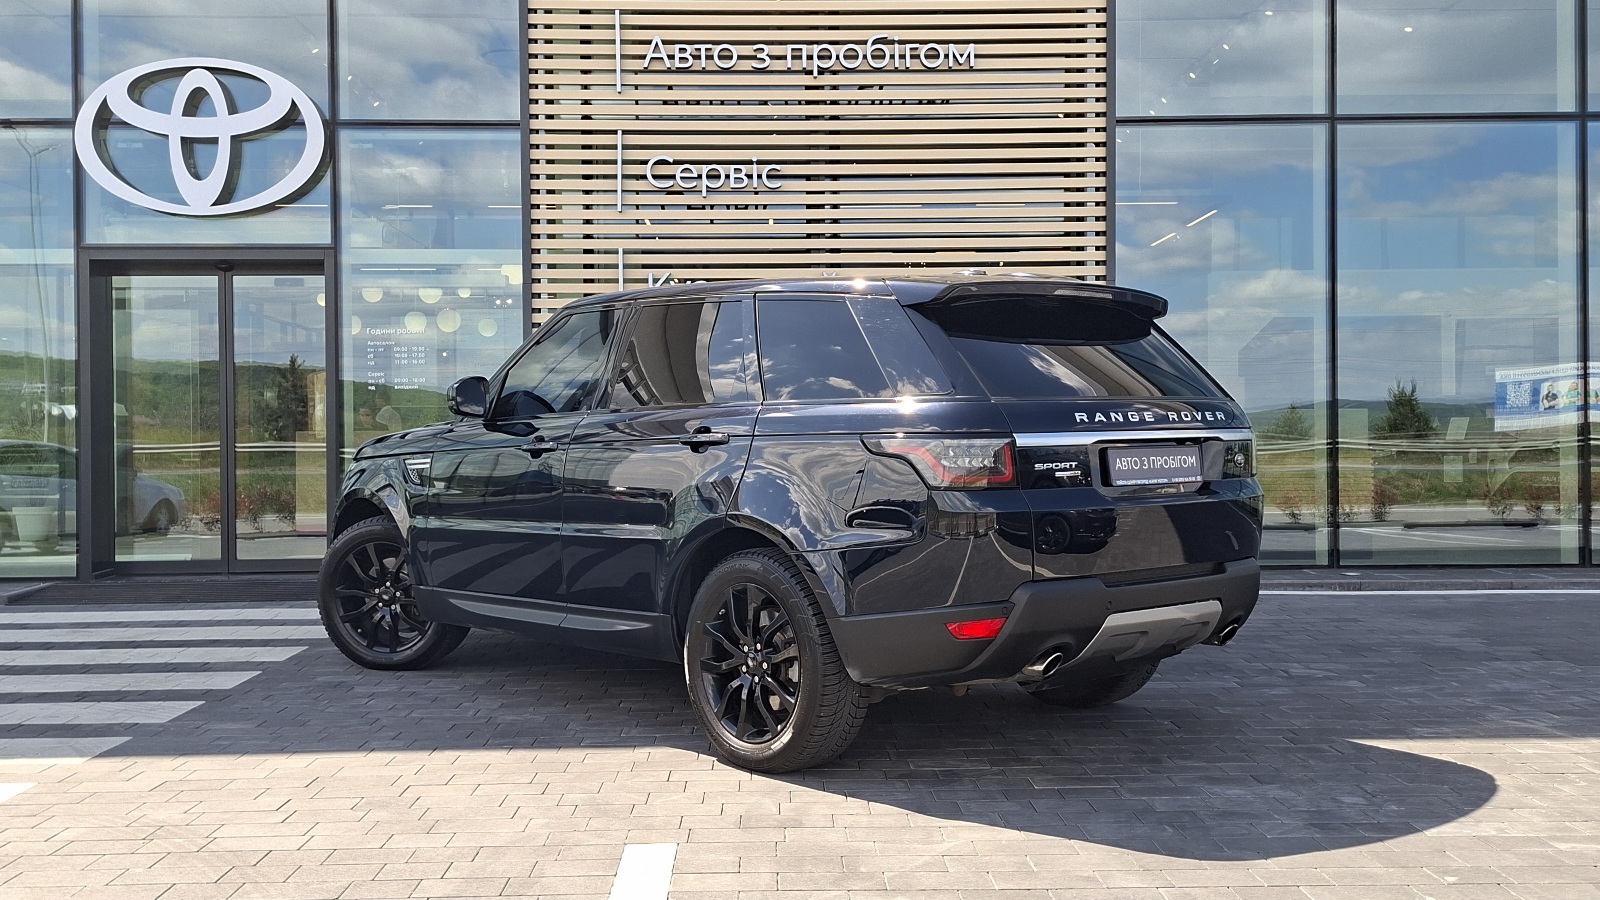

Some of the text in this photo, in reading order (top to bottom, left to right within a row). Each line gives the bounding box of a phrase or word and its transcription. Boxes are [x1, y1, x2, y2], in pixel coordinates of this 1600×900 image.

[642, 33, 975, 79] Авто з пробігом
[646, 155, 782, 198] Сервіс
[366, 327, 396, 335] Години
[1074, 411, 1226, 423] RANGE ROVER
[1034, 461, 1078, 470] SPORT
[1115, 457, 1141, 471] АВТО
[1149, 455, 1197, 469] ПРОБІГОМ
